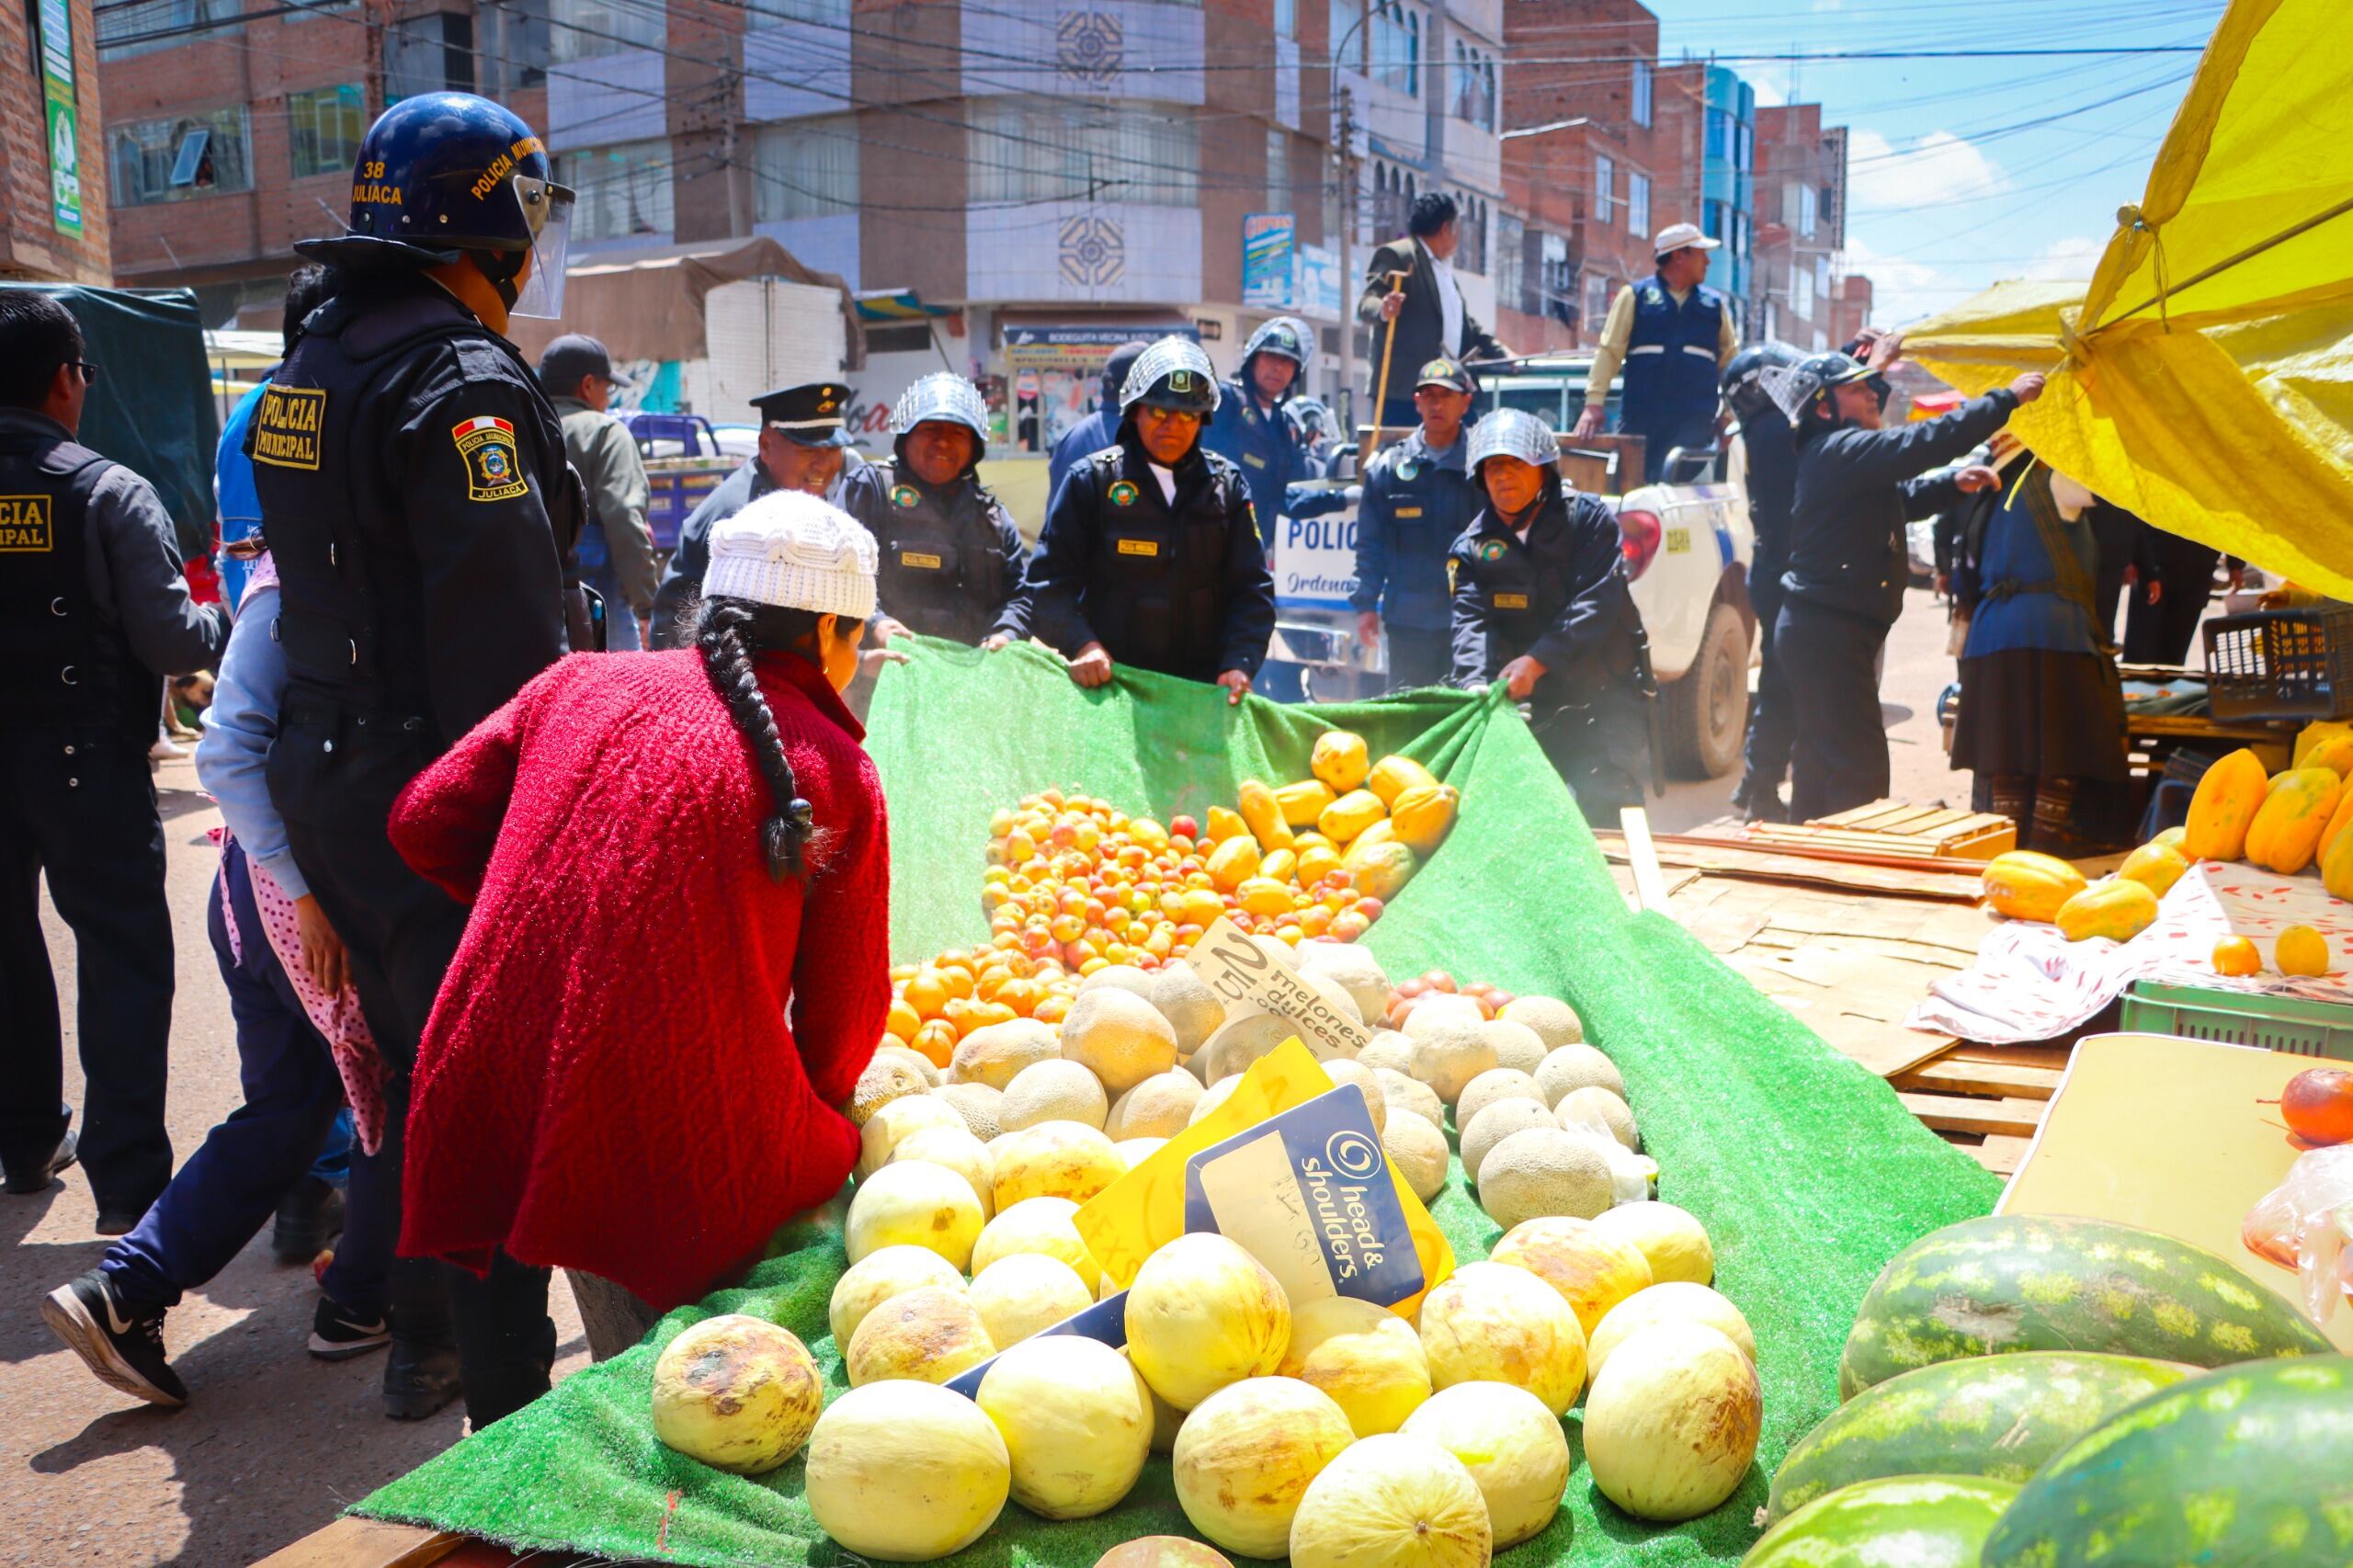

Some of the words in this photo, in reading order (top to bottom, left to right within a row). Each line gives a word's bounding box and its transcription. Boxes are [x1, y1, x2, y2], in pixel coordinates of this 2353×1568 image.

[363, 161, 385, 179] 38
[471, 153, 514, 201] POLICIA
[353, 186, 403, 205] JULIACA
[262, 394, 316, 431] POLICIA
[258, 430, 314, 460] MUNICIPAL
[461, 435, 484, 450] POLICIA
[478, 485, 522, 498] JULIACA
[1211, 932, 1267, 985] 2
[1270, 970, 1368, 1049] melones
[1267, 989, 1341, 1049] dulces
[1302, 1157, 1358, 1278] shoulders
